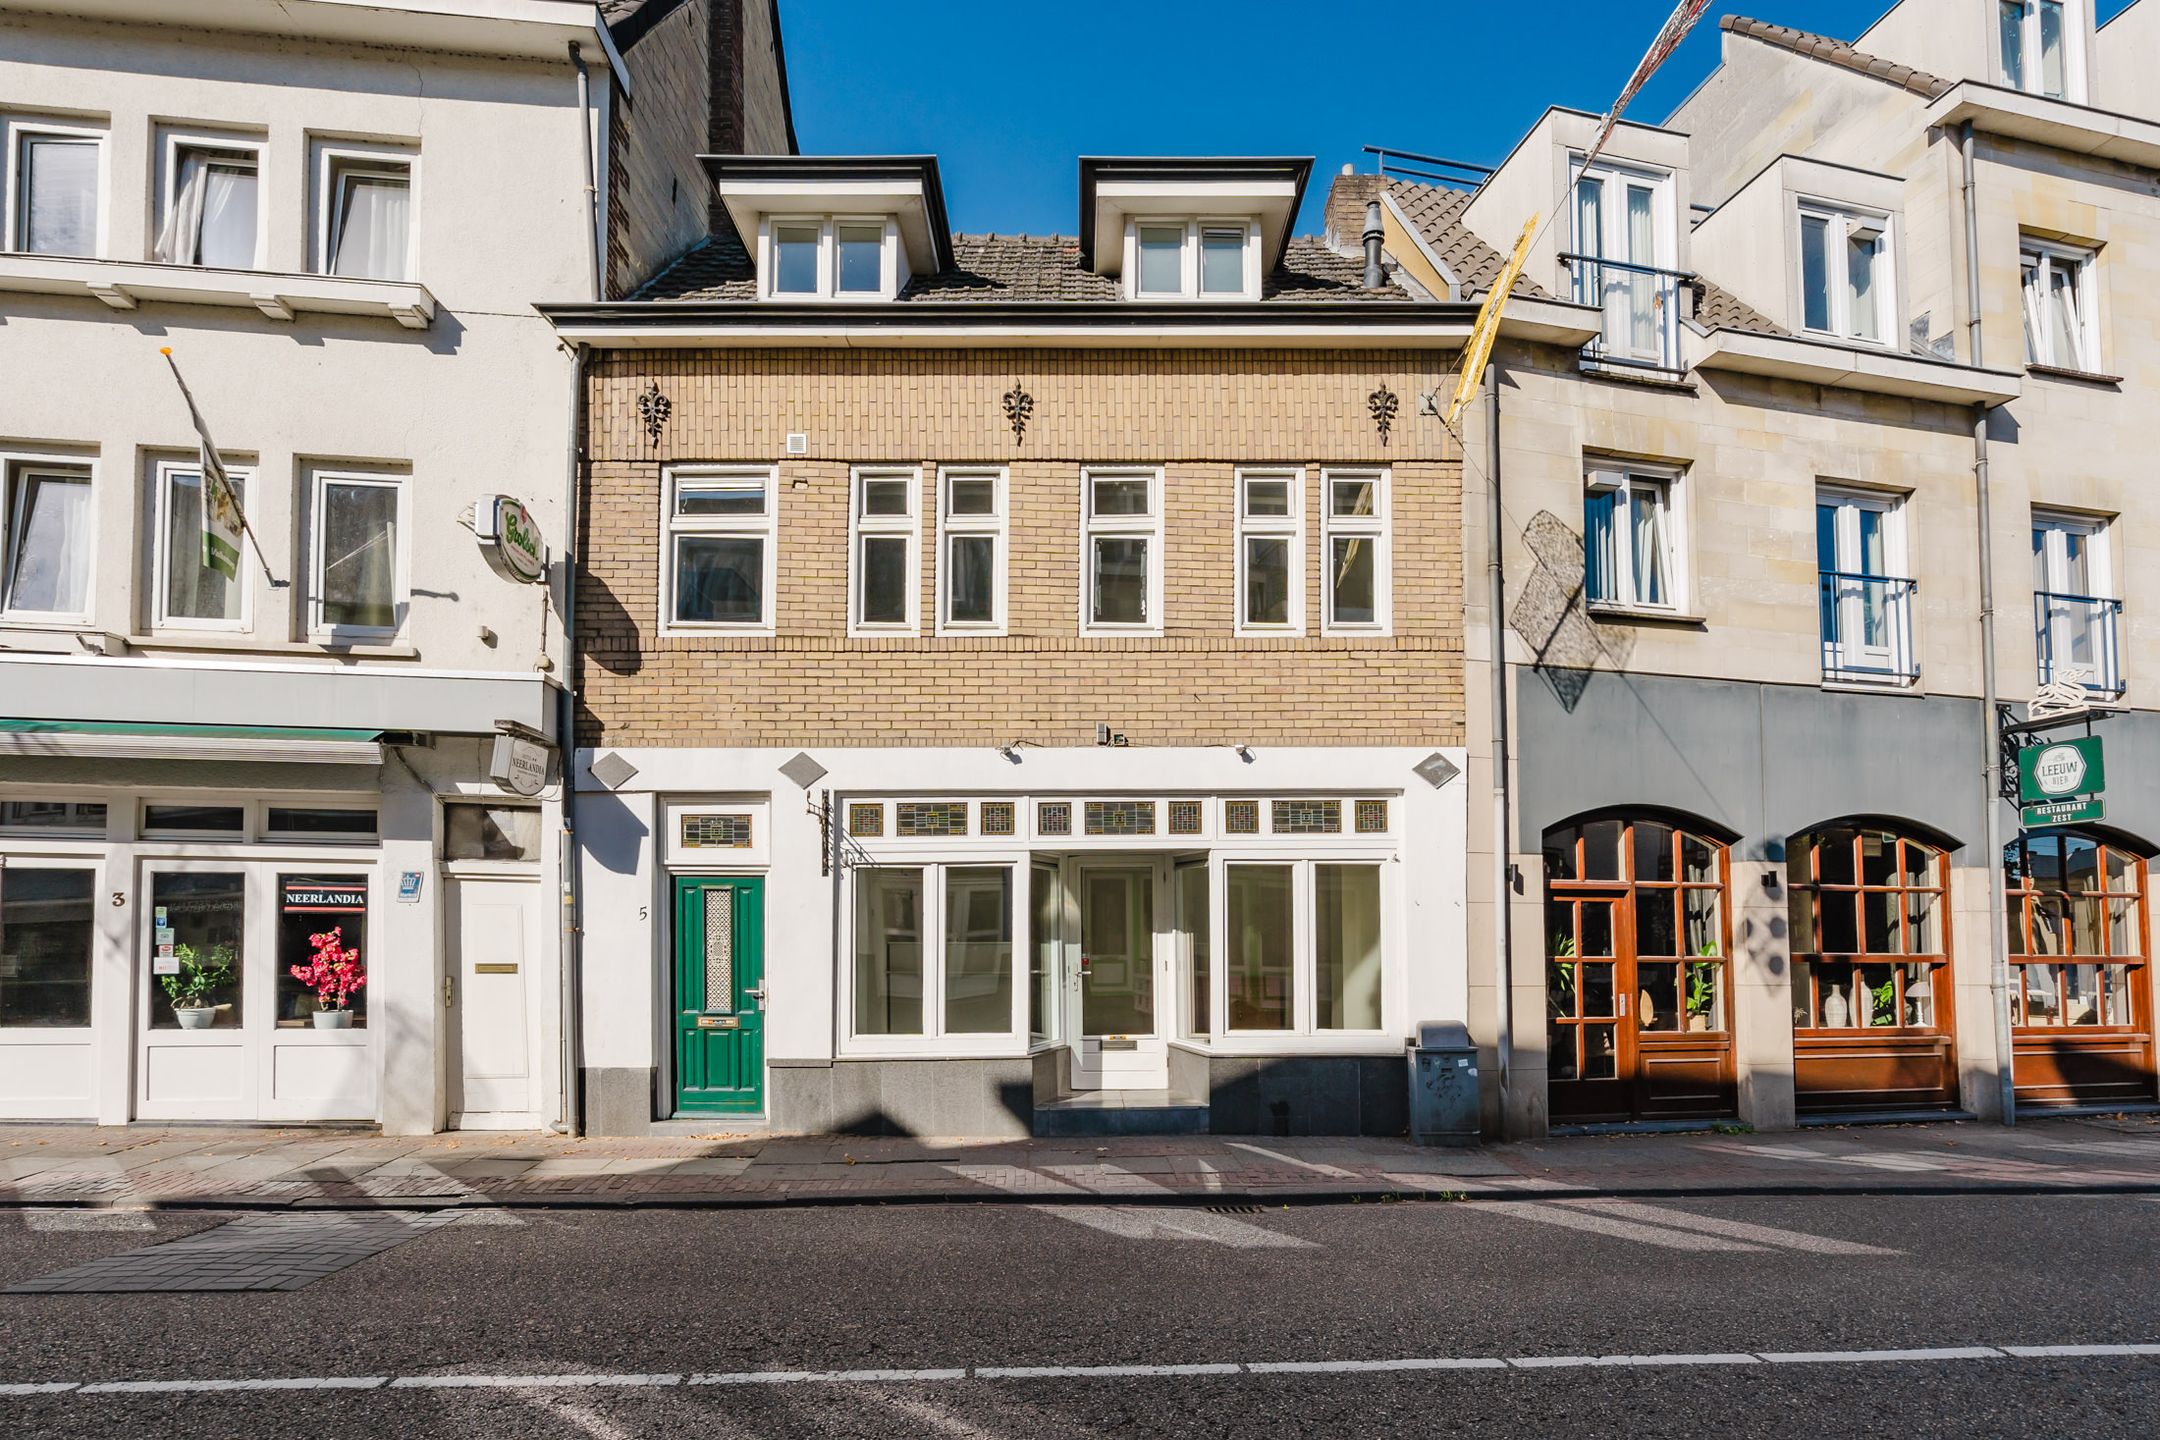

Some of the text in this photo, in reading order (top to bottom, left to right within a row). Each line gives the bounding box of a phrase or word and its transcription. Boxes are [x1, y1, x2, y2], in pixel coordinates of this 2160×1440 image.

[511, 757, 545, 776] NEERLANDIA
[2042, 761, 2078, 777] LEEUW
[2036, 802, 2088, 815] RESTAURANT
[2052, 814, 2072, 823] ZEST
[112, 892, 126, 907] 3
[286, 893, 364, 904] NEERLANDIA
[639, 906, 648, 921] 5
